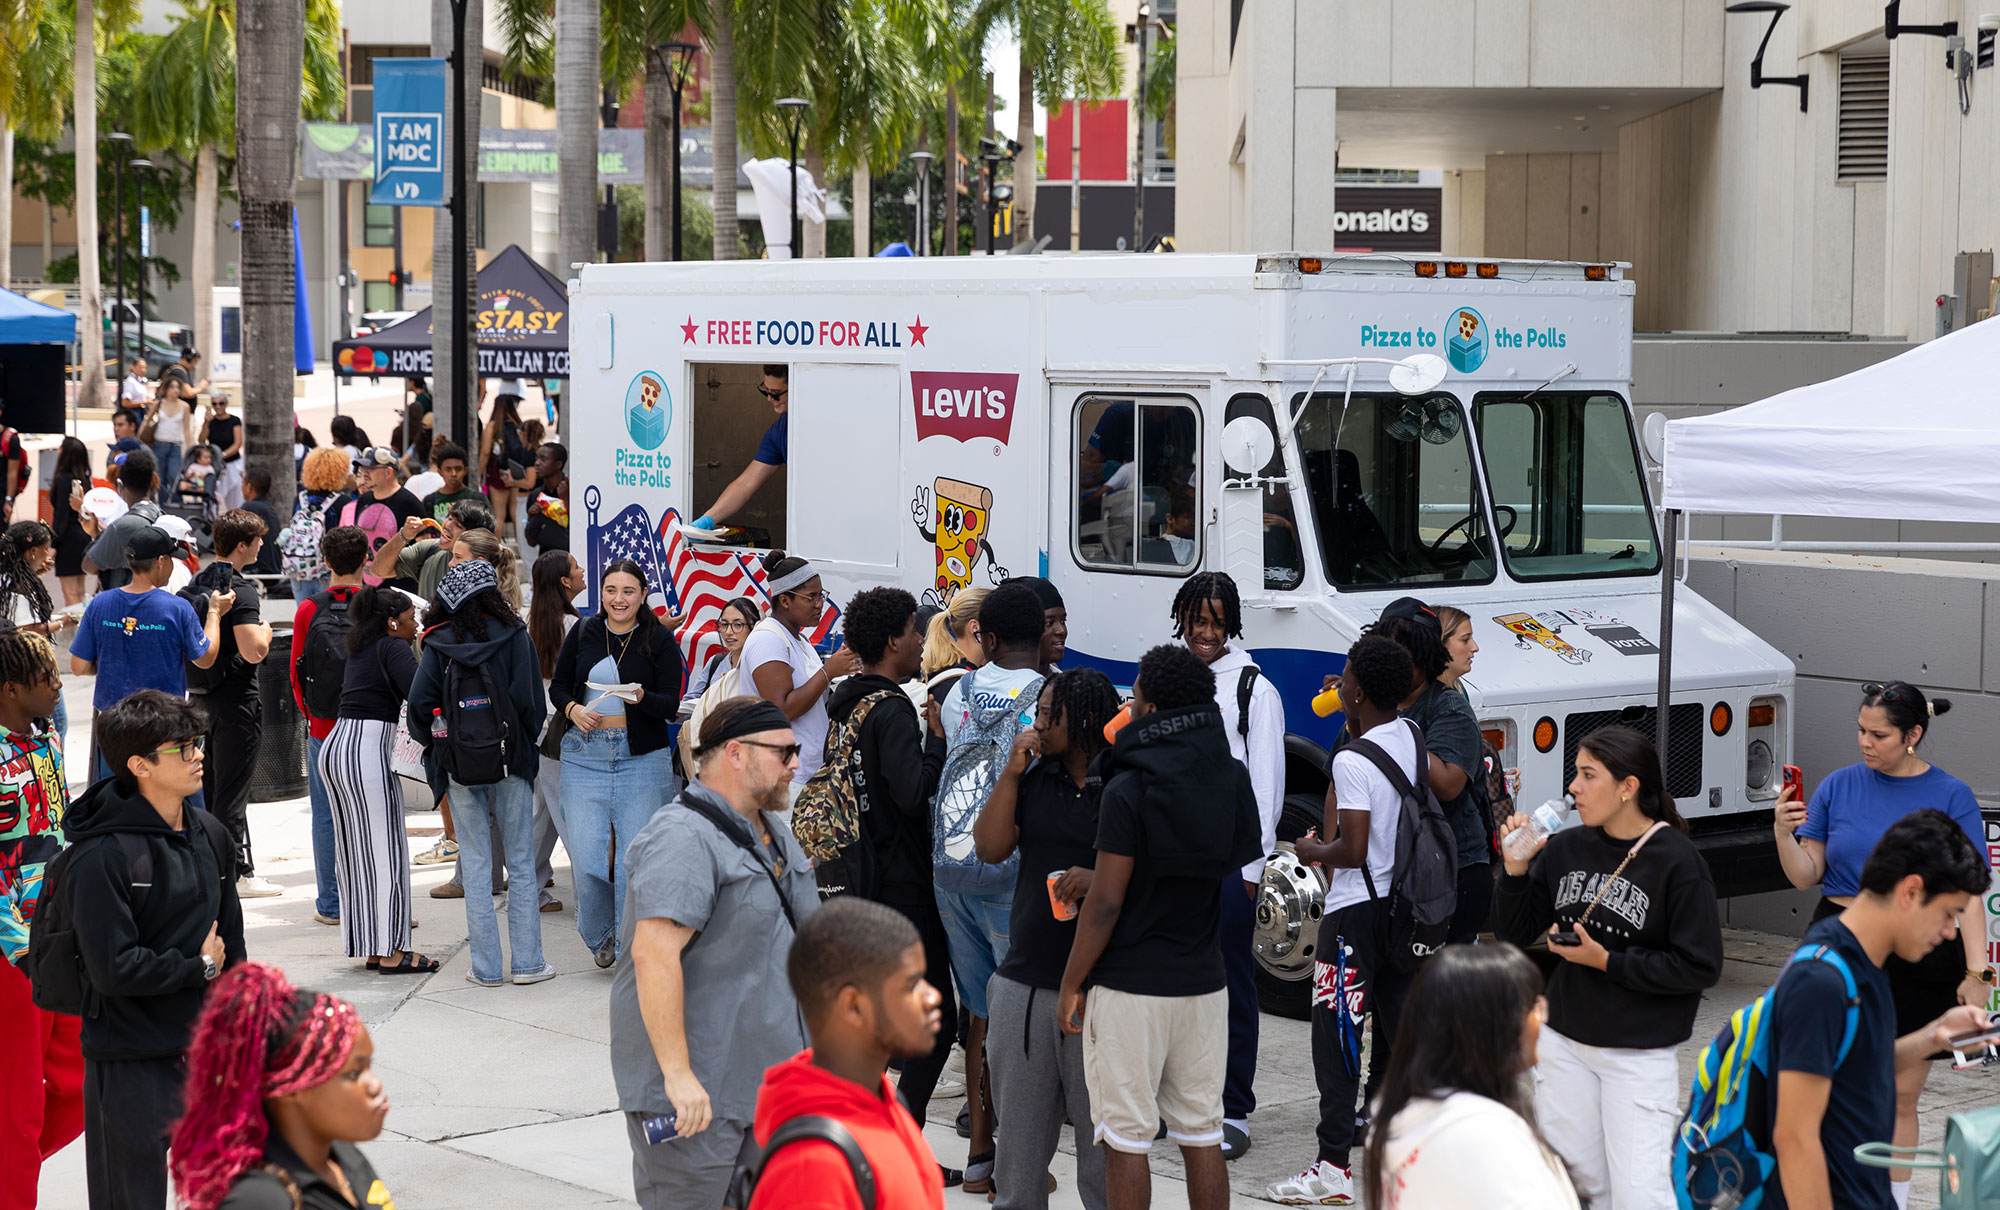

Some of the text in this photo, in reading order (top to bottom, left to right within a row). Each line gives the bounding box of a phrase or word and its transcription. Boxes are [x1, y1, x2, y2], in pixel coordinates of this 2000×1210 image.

[387, 123, 432, 141] I AM
[387, 143, 432, 162] MDC
[1333, 208, 1430, 233] onald's
[707, 320, 902, 348] FREE FOOD FOR ALL
[1360, 324, 1567, 349] Pizza to the Polls
[478, 350, 543, 373] ITALIAN
[616, 447, 672, 469] Pizza to
[614, 467, 672, 489] the Polls
[1608, 637, 1651, 649] VOTE
[1555, 871, 1587, 911] LOS
